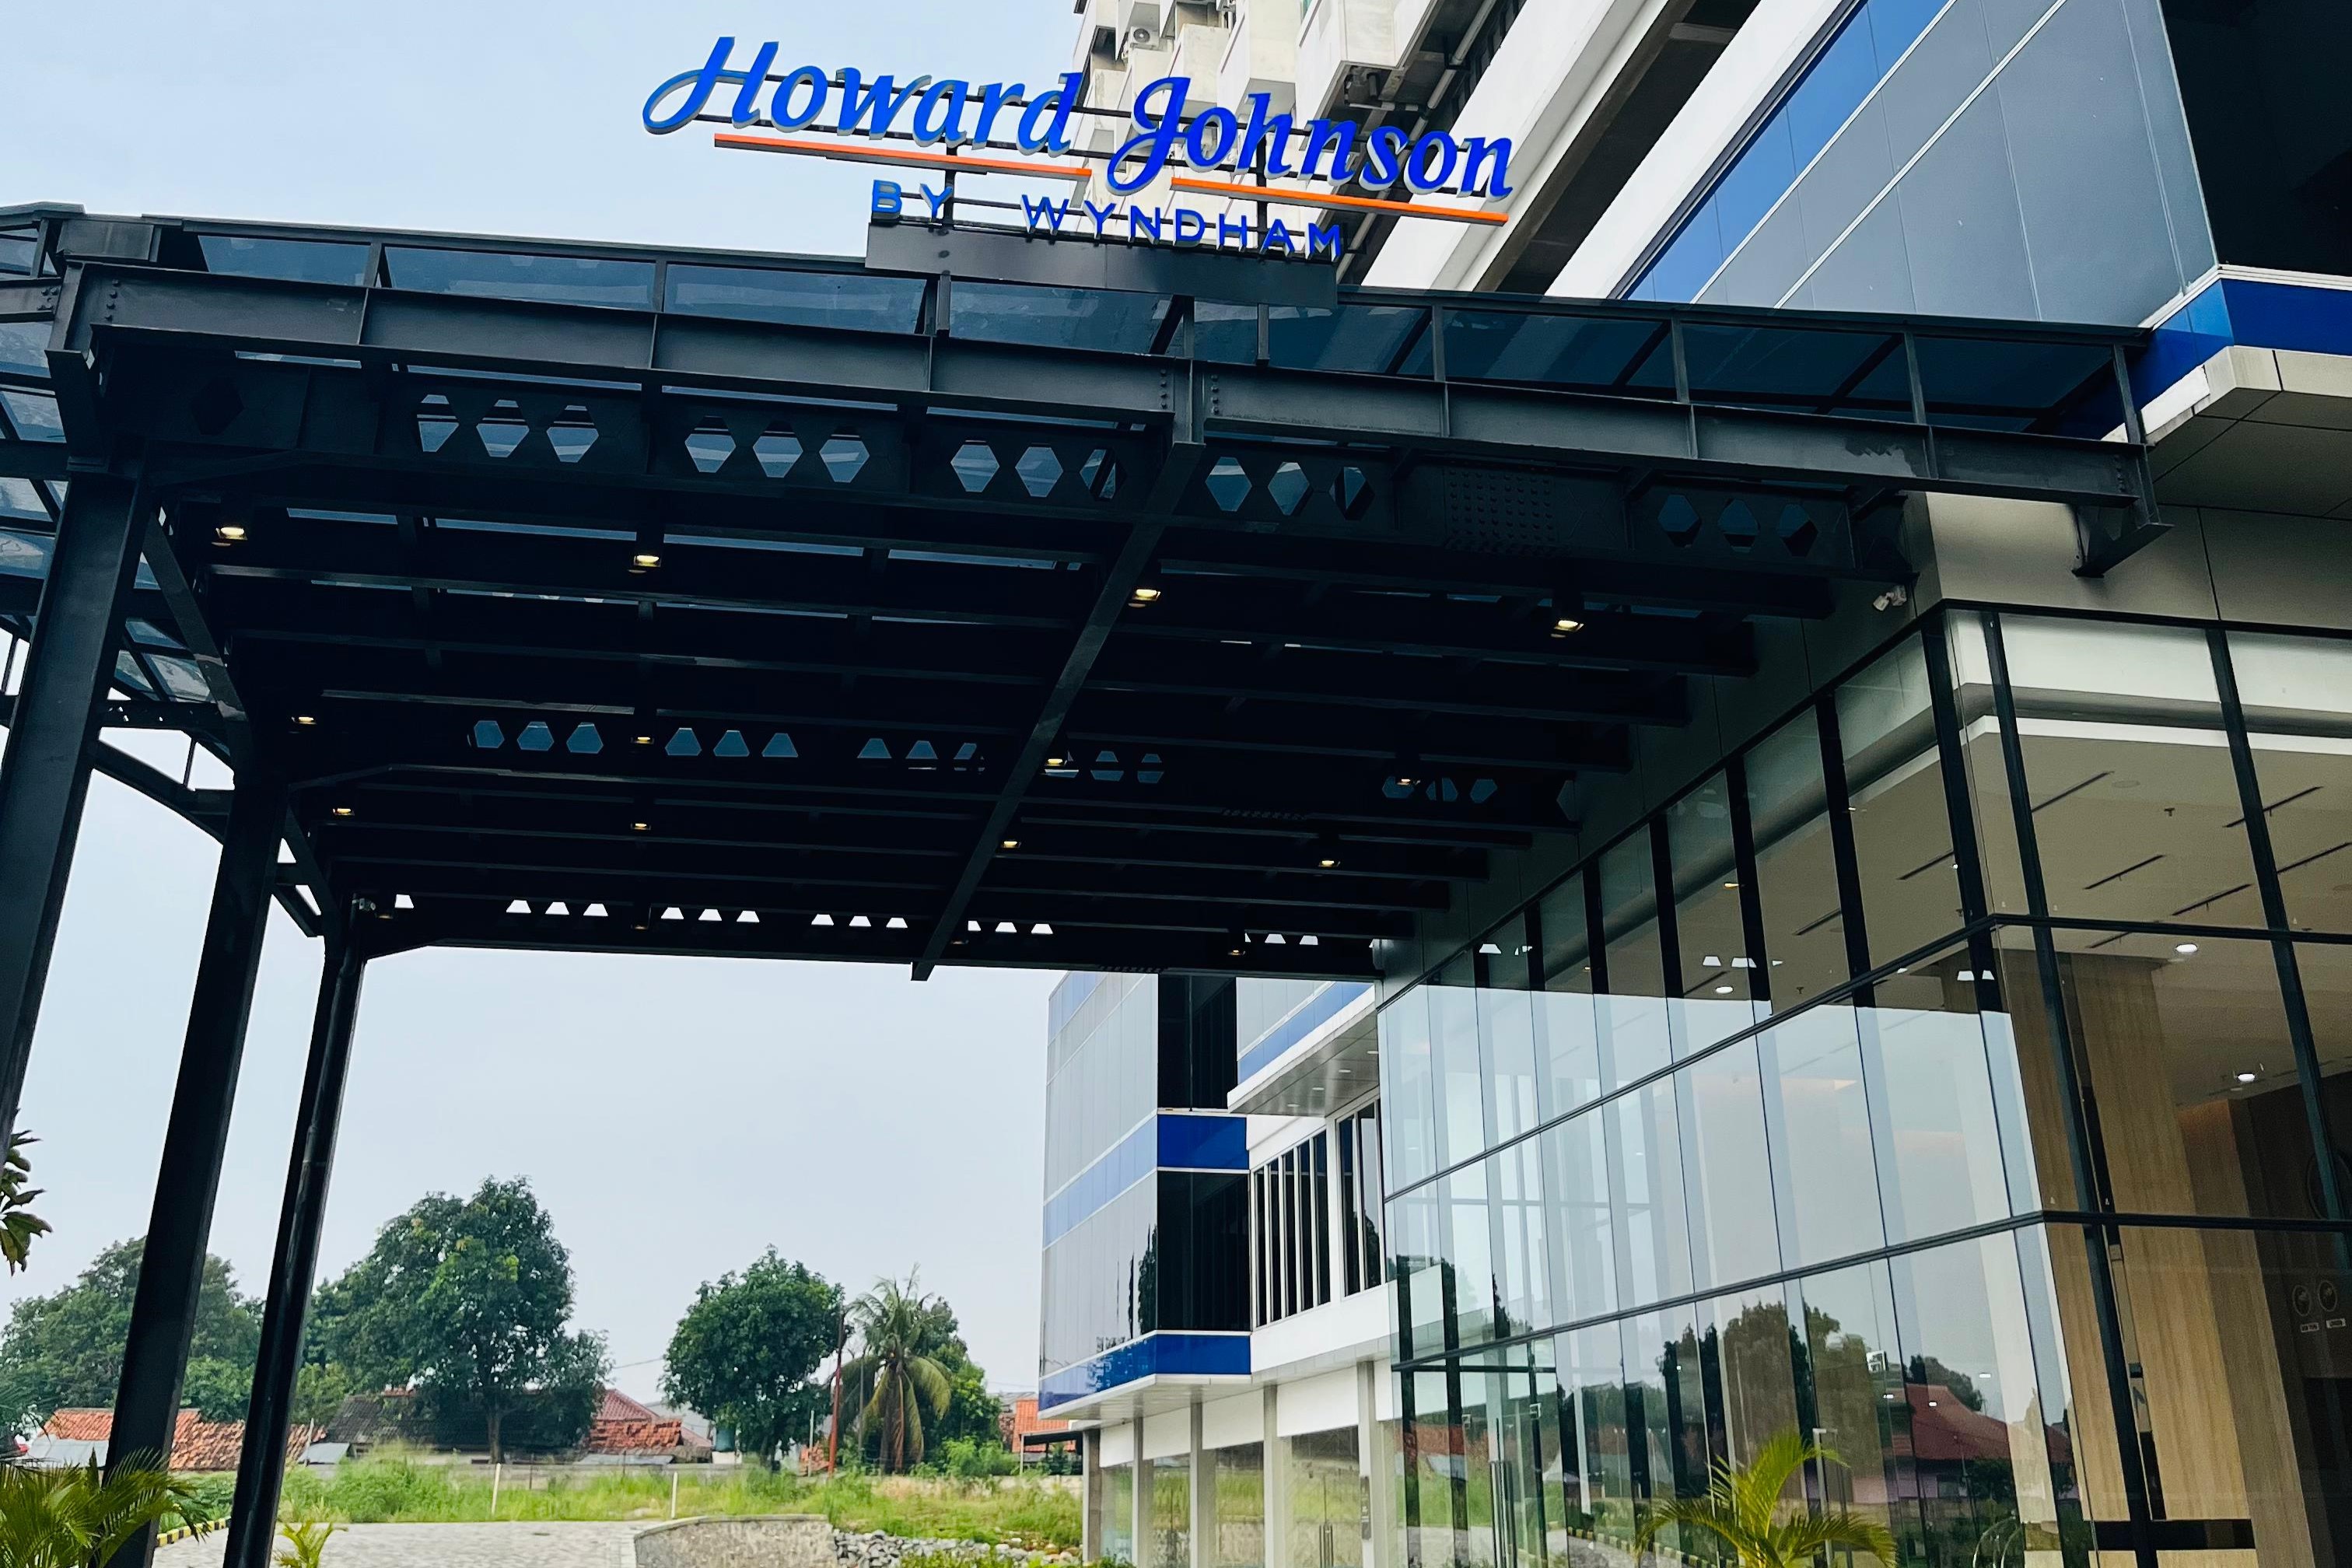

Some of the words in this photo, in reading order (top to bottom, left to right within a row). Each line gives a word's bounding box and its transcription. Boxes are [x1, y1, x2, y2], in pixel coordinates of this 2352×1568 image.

[642, 37, 1083, 158] Howard
[1106, 76, 1514, 203] Johnson
[871, 180, 953, 219] BY
[1021, 194, 1341, 262] WYNDHAM
